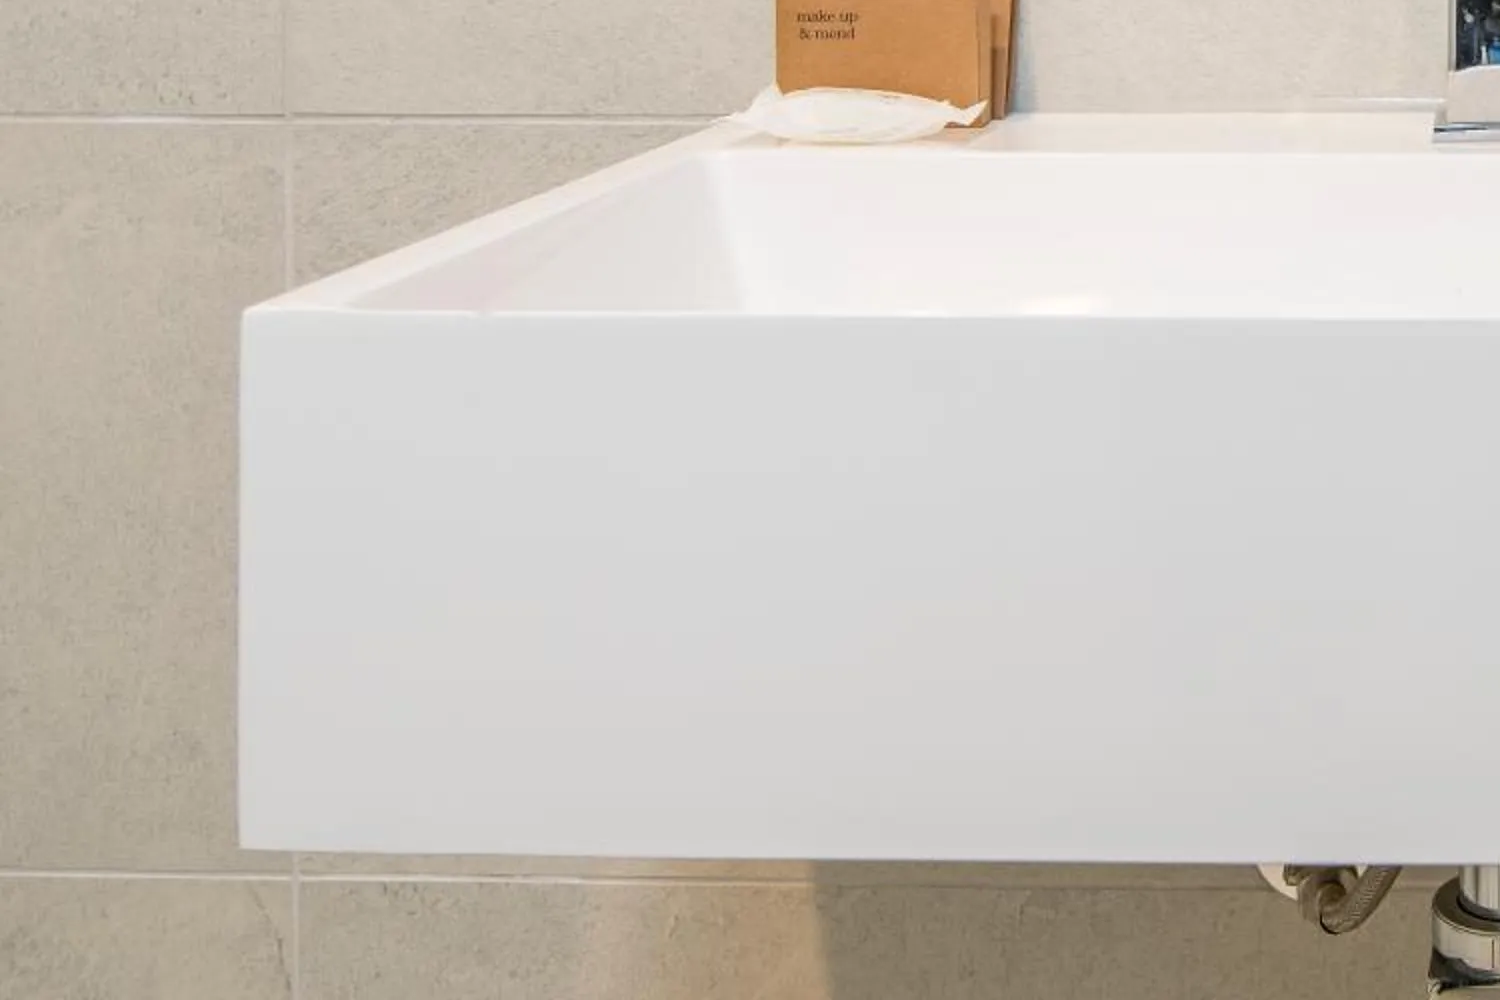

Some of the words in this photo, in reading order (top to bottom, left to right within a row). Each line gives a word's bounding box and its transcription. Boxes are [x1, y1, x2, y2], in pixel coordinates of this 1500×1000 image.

[797, 9, 836, 23] make
[839, 11, 860, 24] up
[799, 28, 809, 40] &
[812, 27, 855, 39] mend
